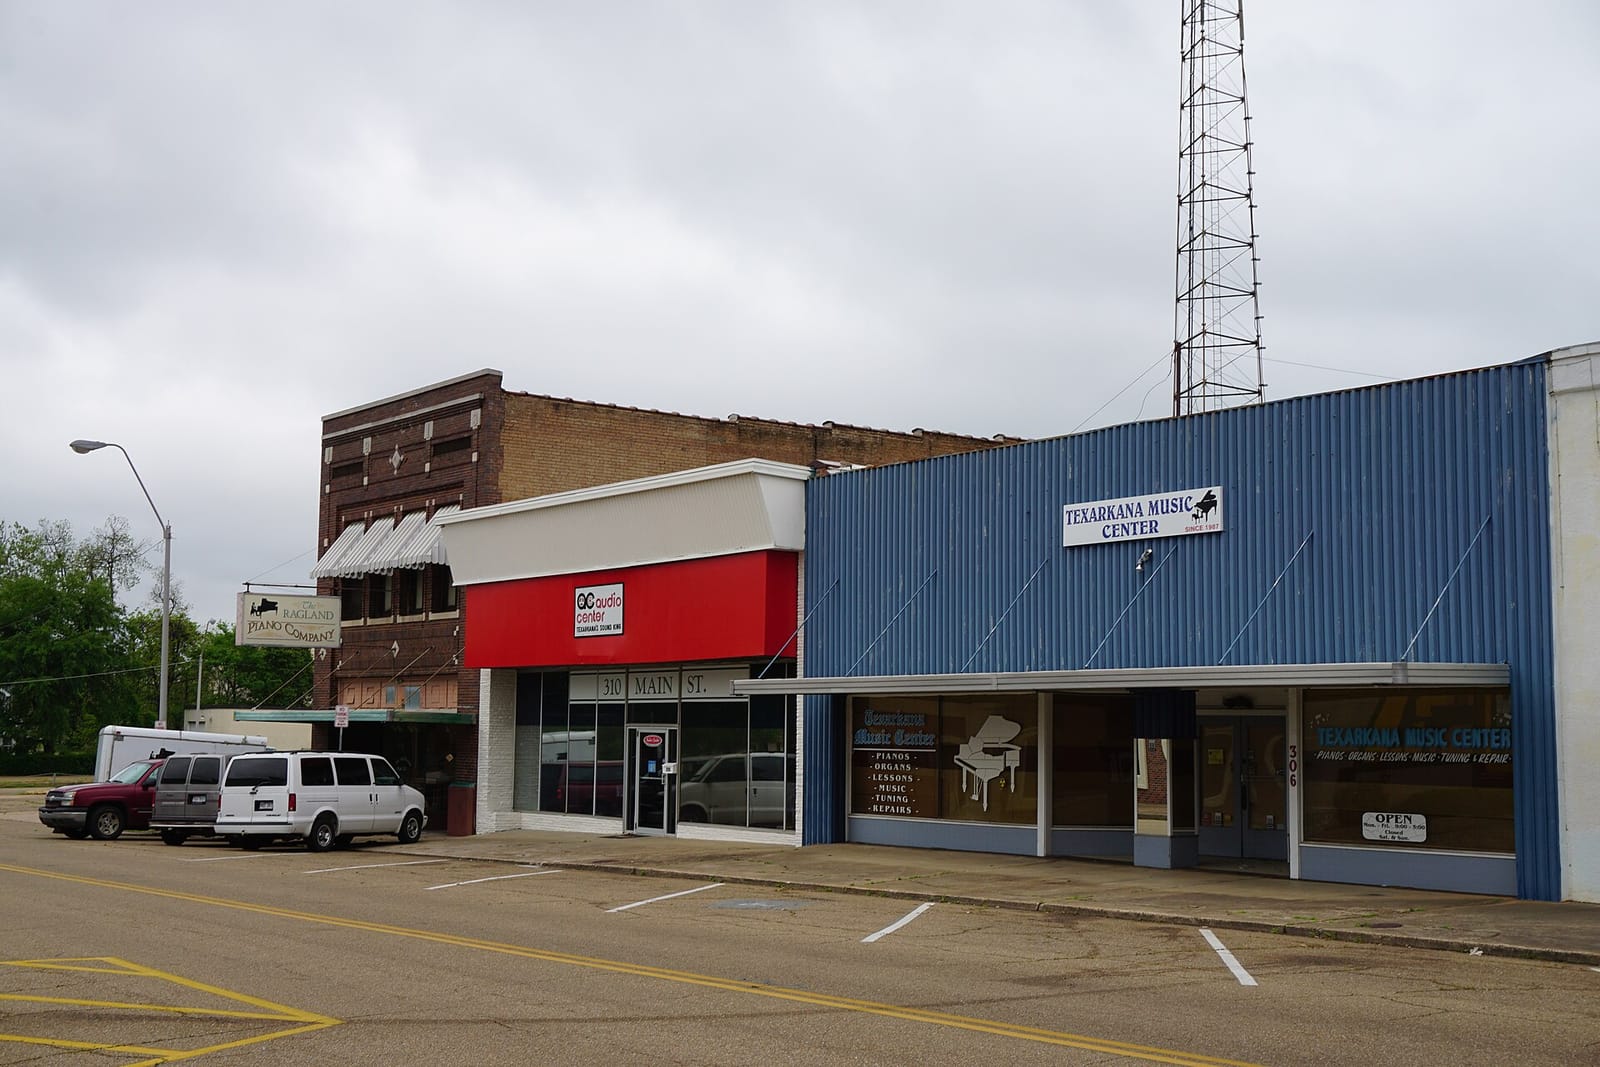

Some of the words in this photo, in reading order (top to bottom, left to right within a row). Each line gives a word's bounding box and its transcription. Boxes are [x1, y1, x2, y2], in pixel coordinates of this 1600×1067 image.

[1066, 502, 1143, 525] TEXARKANA
[1148, 495, 1194, 516] MUSIC
[1102, 519, 1159, 538] CENTER
[1184, 524, 1204, 533] SINCE
[595, 592, 621, 608] audio
[283, 609, 335, 620] RAGLAND
[576, 610, 605, 623] center
[247, 620, 282, 634] PIANO
[602, 678, 622, 696] 310
[634, 676, 674, 696] MAIN
[686, 674, 708, 694] ST.
[894, 728, 936, 746] Center
[1318, 727, 1402, 748] TEXARKANA
[1404, 727, 1448, 748] MUSIC
[1450, 727, 1512, 750] CENTER
[1440, 752, 1471, 763] TUNING
[1289, 745, 1297, 788] 306
[1375, 813, 1412, 824] OPEN
